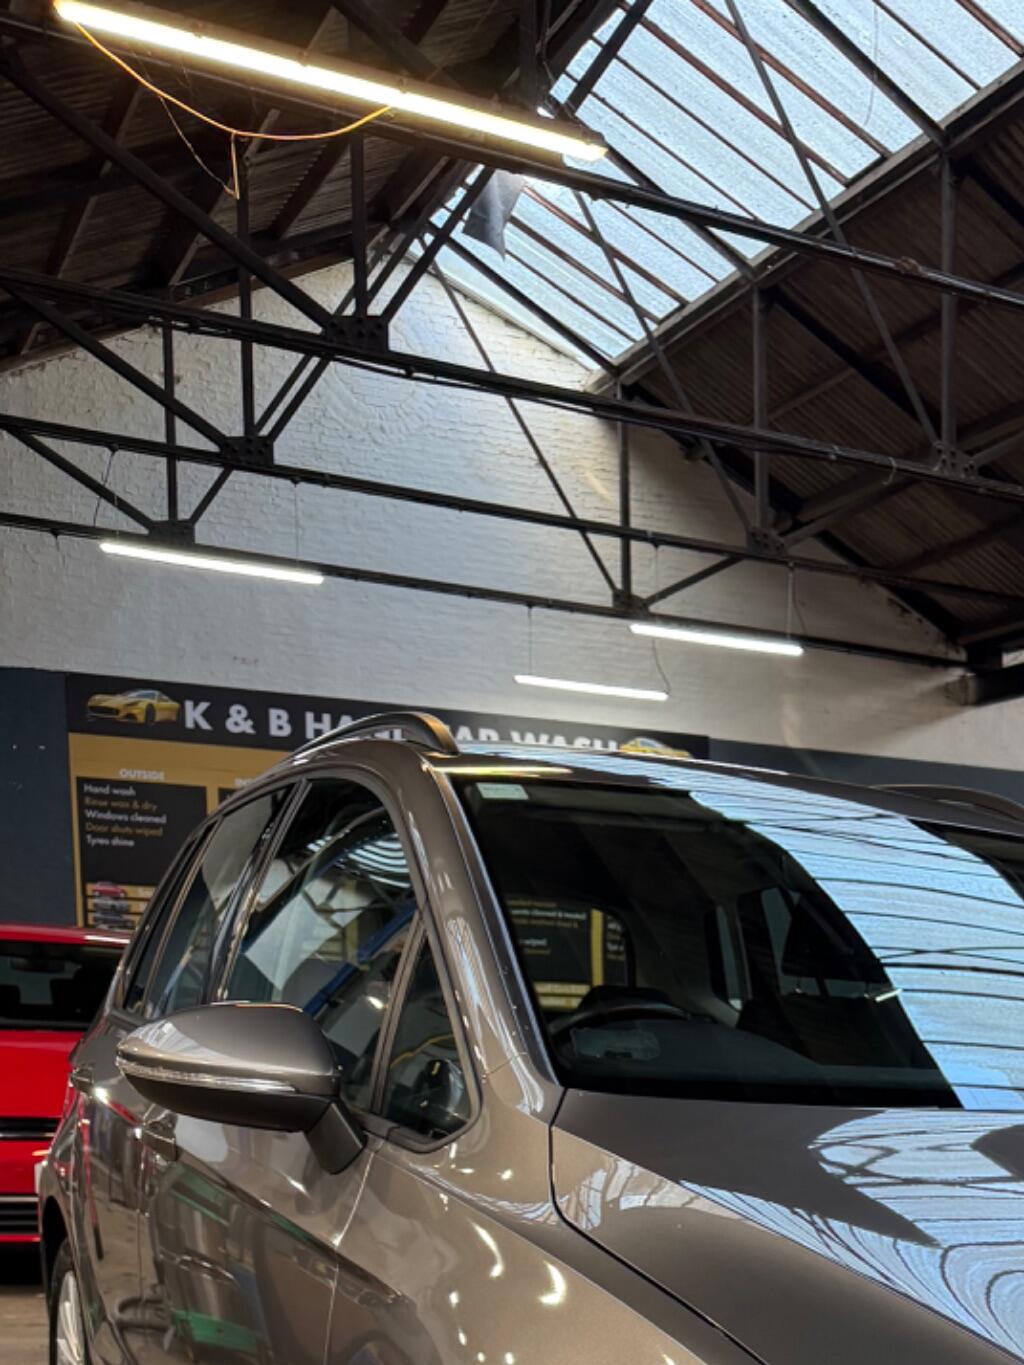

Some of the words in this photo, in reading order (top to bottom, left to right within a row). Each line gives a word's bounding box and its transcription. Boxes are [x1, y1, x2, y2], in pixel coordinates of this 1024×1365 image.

[184, 699, 213, 731] K
[225, 704, 256, 735] &
[268, 708, 292, 737] B
[119, 768, 165, 780] OUTSIDE
[83, 783, 110, 795] Hand
[112, 786, 136, 796] wash
[84, 809, 129, 822] Windows
[130, 812, 167, 824] cleaned
[86, 834, 109, 847] Tyres
